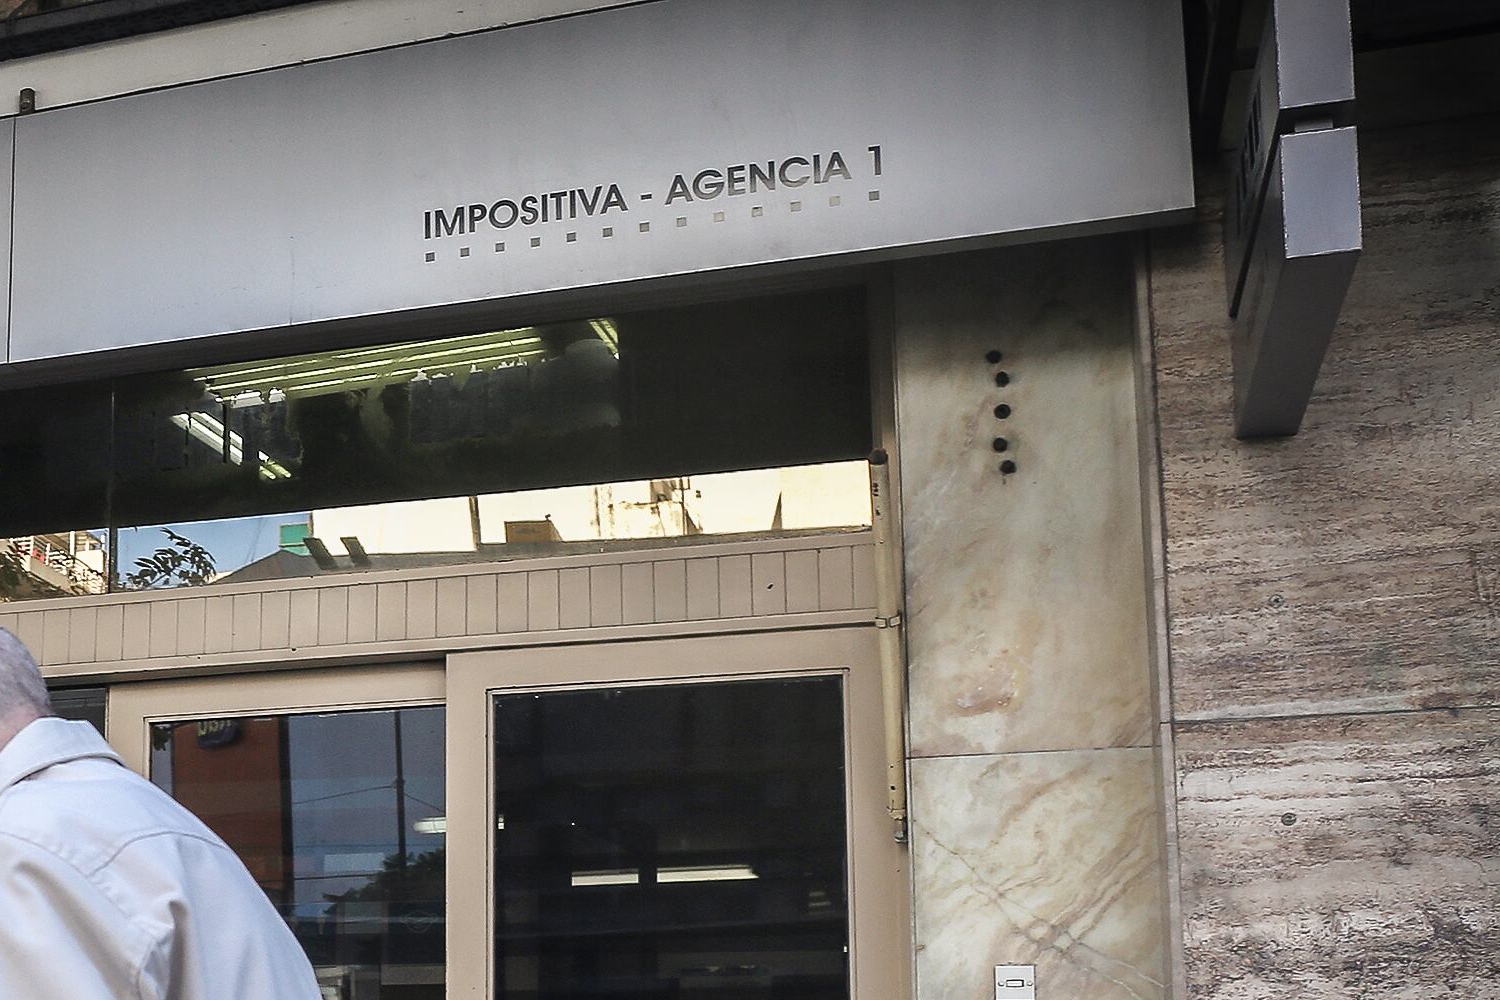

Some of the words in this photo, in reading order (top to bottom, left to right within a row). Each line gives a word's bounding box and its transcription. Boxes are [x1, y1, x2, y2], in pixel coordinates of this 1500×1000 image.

[423, 183, 628, 239] IMPOSITIVA
[664, 151, 852, 206] AGENCIA
[867, 145, 882, 175] 1
